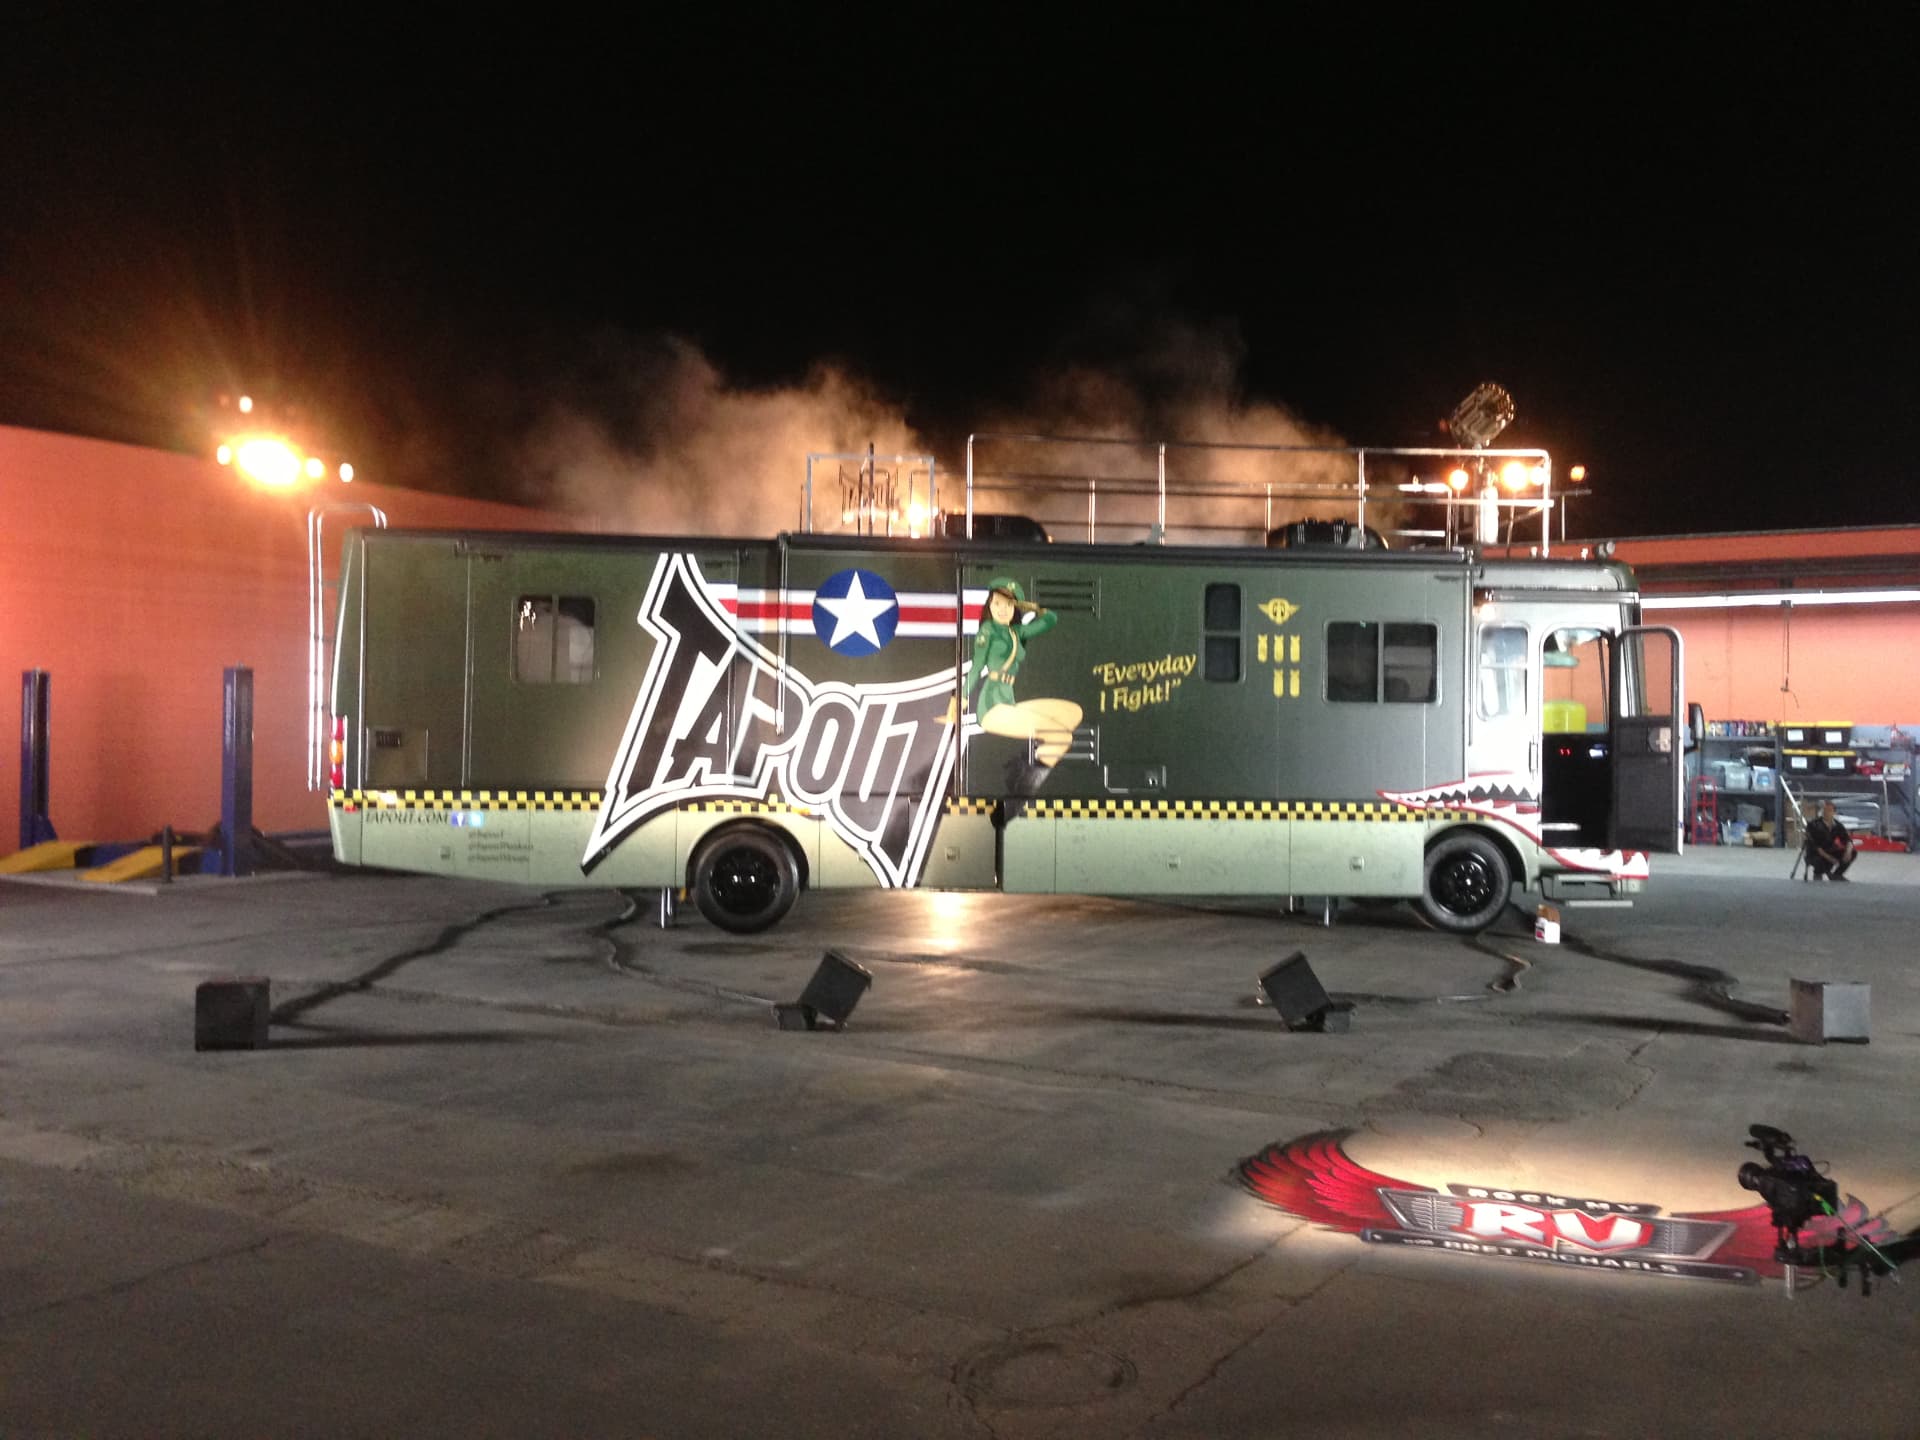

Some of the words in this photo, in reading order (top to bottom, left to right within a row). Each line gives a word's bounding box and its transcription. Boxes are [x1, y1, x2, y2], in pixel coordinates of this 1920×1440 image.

[1100, 690, 1105, 712] I
[1467, 1187, 1566, 1206] ROCK
[1585, 1201, 1639, 1213] MY
[1467, 1202, 1642, 1248] RV
[1443, 1240, 1517, 1255] BRET
[1526, 1249, 1679, 1273] MICHAELS
